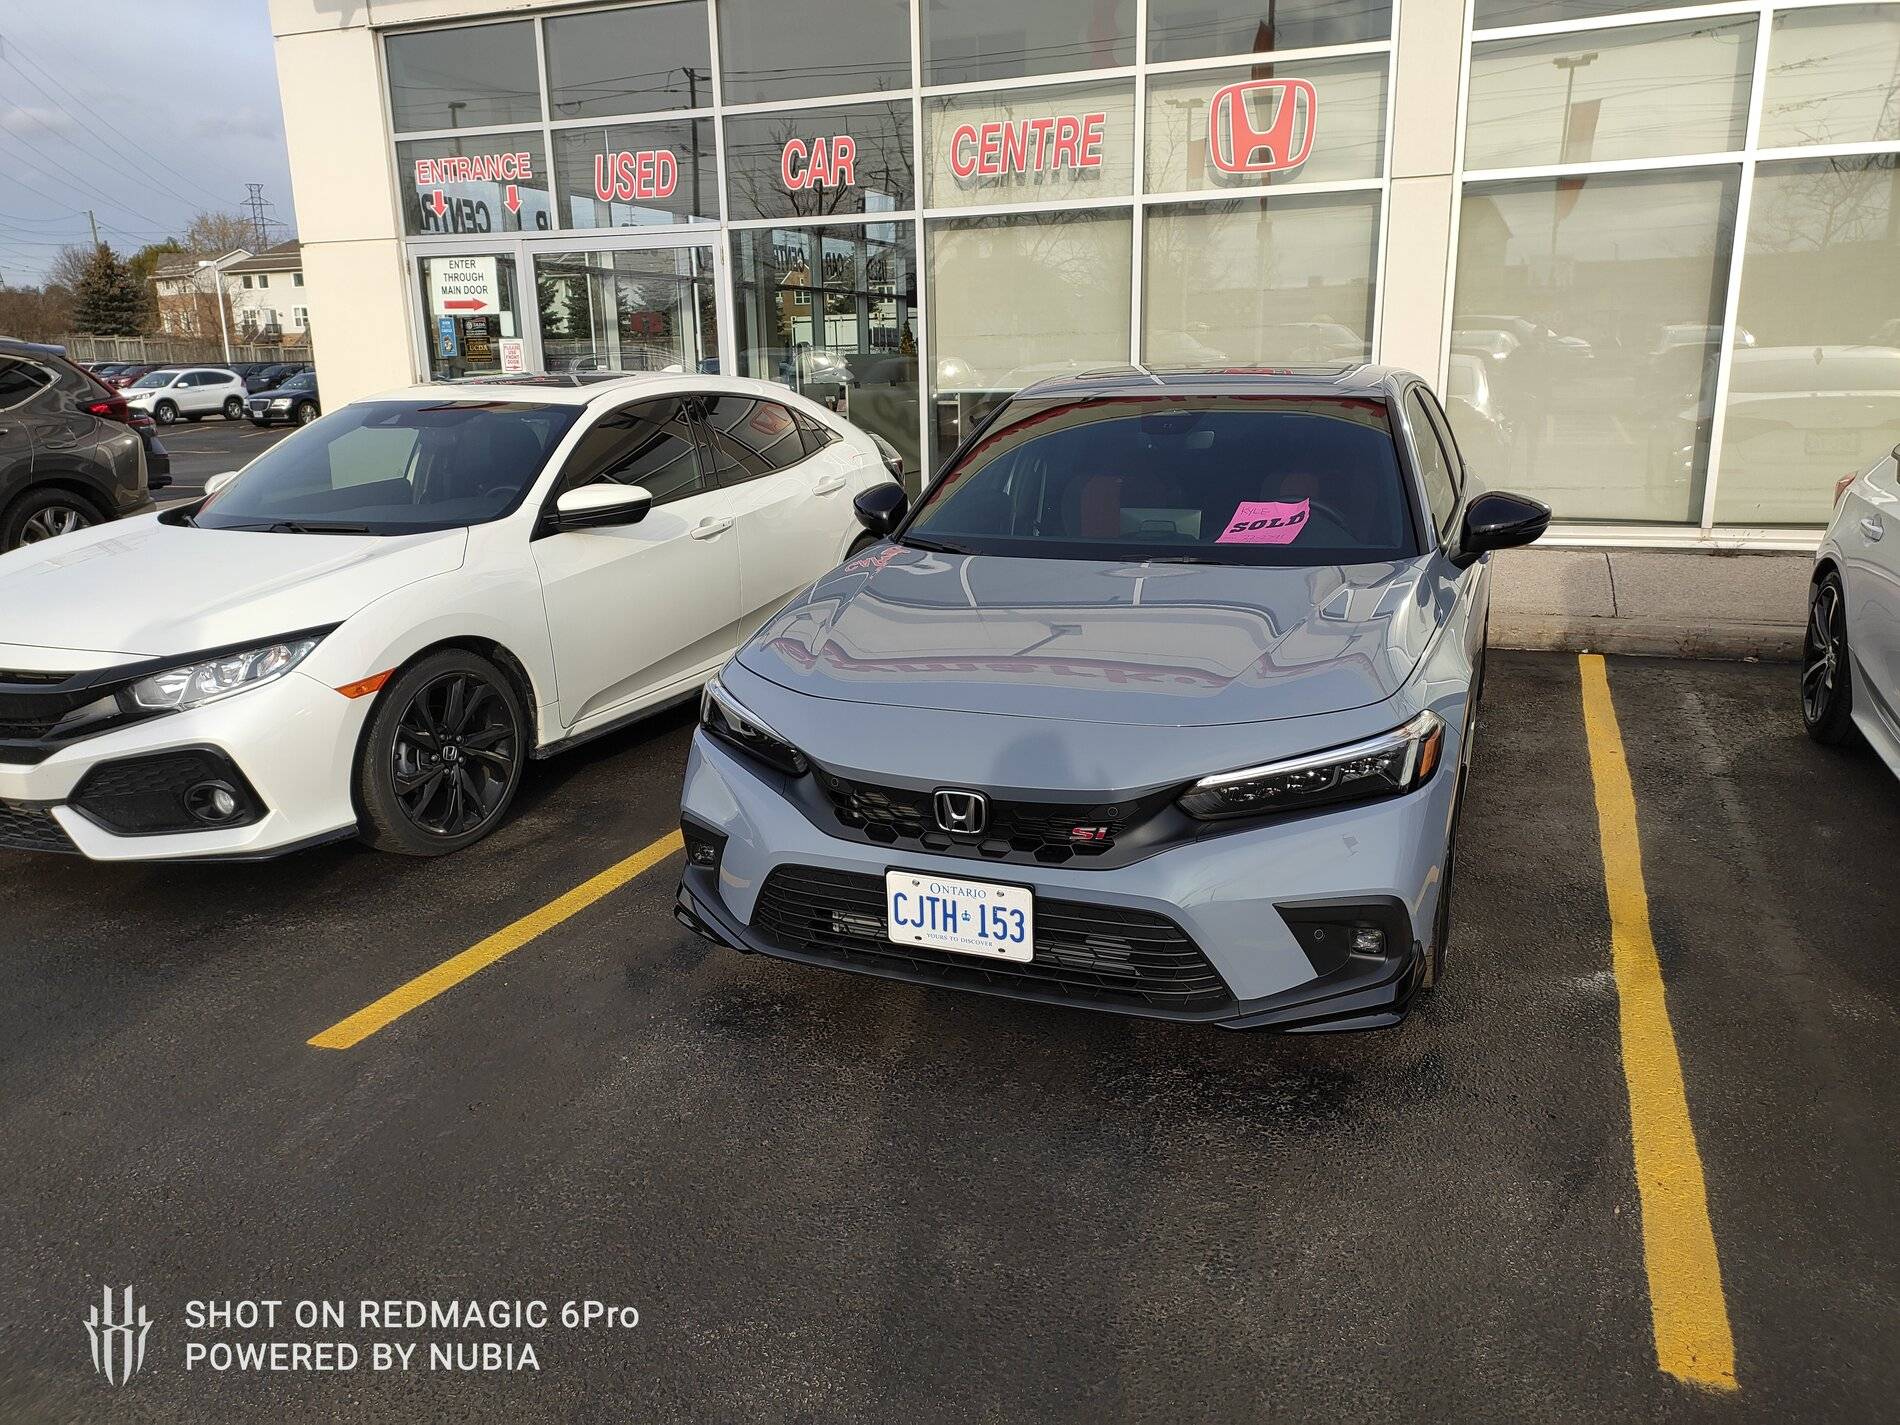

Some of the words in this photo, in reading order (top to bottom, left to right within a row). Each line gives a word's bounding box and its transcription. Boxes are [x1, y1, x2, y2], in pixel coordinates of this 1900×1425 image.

[416, 152, 532, 185] ENTRANCE
[594, 150, 678, 202] USED
[781, 135, 855, 190] CAR
[950, 111, 1107, 178] CENTRE
[449, 259, 476, 269] ENTER
[443, 272, 484, 282] THROUGH
[441, 285, 461, 294] MAIN
[464, 285, 489, 294] DOOR
[1229, 511, 1306, 533] SOLD
[930, 882, 987, 899] ONTARIO
[926, 932, 948, 942] YOURS
[950, 935, 959, 943] TO
[961, 937, 993, 948] DISCOVER
